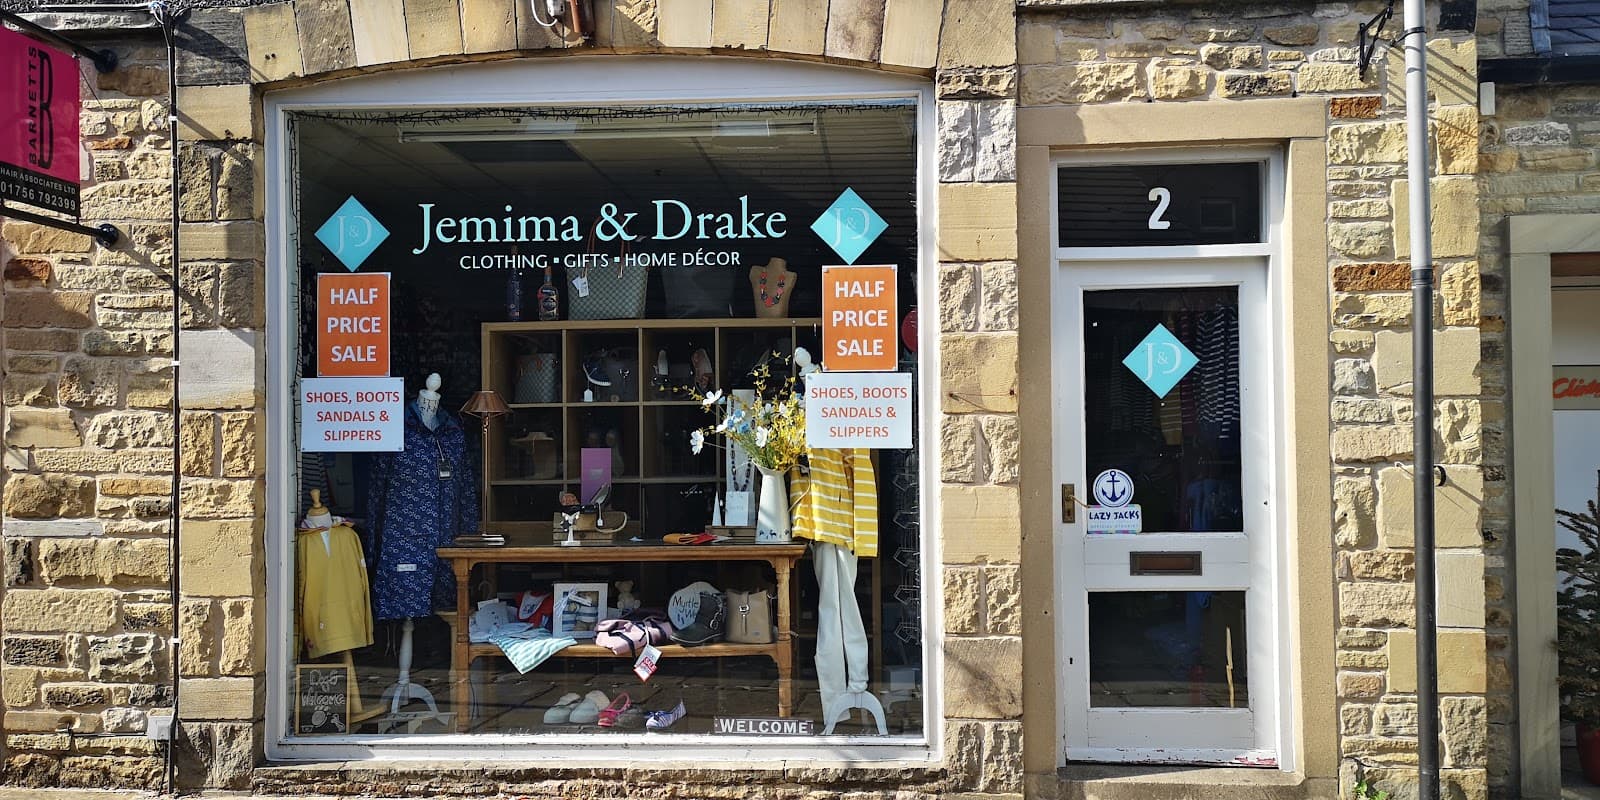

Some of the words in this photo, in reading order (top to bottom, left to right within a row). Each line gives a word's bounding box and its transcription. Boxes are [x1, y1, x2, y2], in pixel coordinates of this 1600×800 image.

[28, 45, 37, 165] BARNETTS
[0, 167, 18, 178] HAIR
[20, 173, 63, 190] ASSOCIATES
[64, 186, 76, 194] LTD
[0, 181, 35, 200] 01756
[38, 191, 76, 211] 792399
[1148, 187, 1171, 230] 2
[412, 203, 583, 254] Jemima
[595, 202, 639, 241] &
[651, 195, 787, 240] Drake
[459, 254, 548, 269] CLOTHING
[563, 253, 610, 268] GIFTS
[624, 252, 677, 267] HOME
[682, 247, 741, 266] DÉCOR
[330, 288, 378, 305] HALF
[835, 280, 885, 298] HALF
[327, 316, 382, 334] PRICE
[832, 309, 889, 327] PRICE
[331, 345, 377, 362] SALE
[836, 339, 884, 357] SALE
[306, 391, 352, 404] SHOES,
[356, 391, 400, 403] BOOTS
[811, 387, 858, 400] SHOES,
[862, 387, 908, 398] BOOTS
[316, 410, 375, 423] SANDALS
[379, 410, 390, 423] &
[821, 406, 882, 419] SANDALS
[886, 406, 897, 418] &
[324, 430, 382, 442] SLIPPERS
[829, 426, 889, 438] SLIPPERS
[1089, 511, 1111, 520] LAZY
[1113, 510, 1140, 520] JACKS
[719, 718, 809, 734] WELCOME
